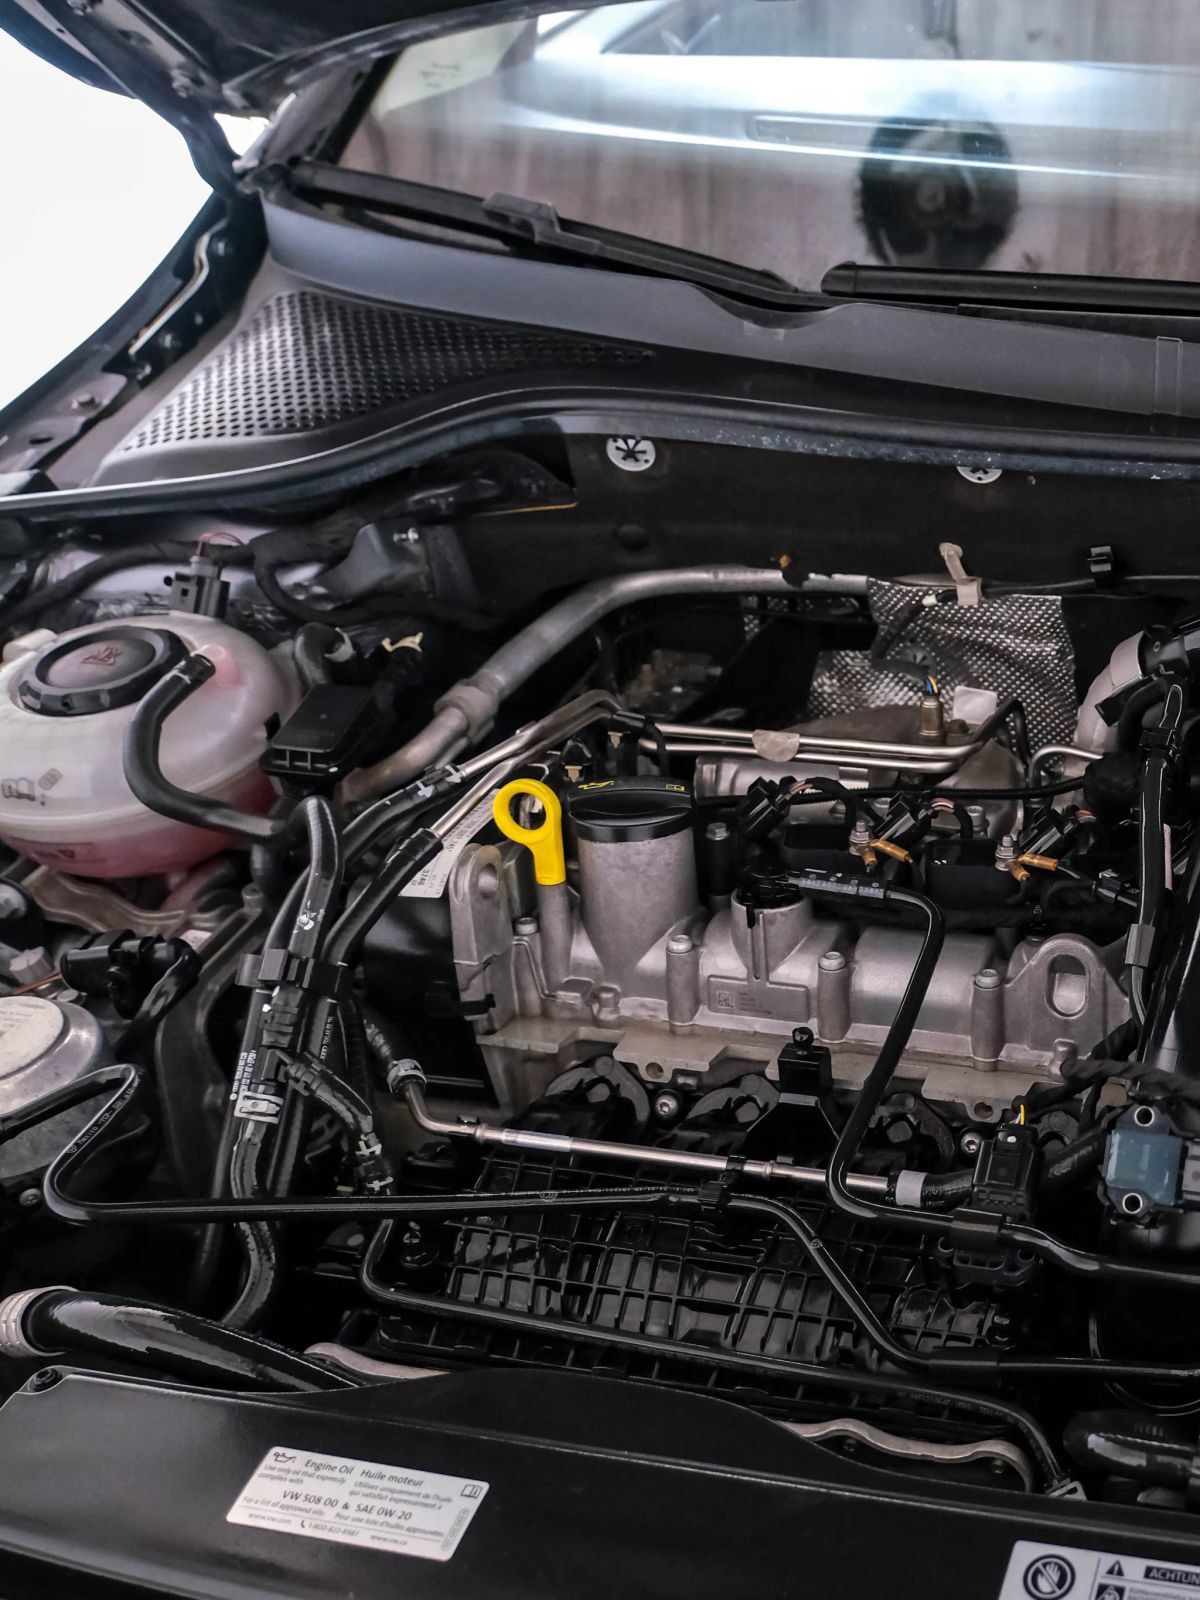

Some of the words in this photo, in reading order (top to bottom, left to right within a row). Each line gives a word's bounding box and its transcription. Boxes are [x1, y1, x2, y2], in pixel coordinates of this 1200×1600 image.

[305, 1460, 337, 1471] Engine
[339, 1465, 354, 1474] Oil
[361, 1469, 386, 1480] Huile
[387, 1474, 424, 1486] moteur
[283, 1490, 302, 1500] VW
[304, 1493, 322, 1505] 508
[323, 1497, 339, 1507] 00
[355, 1503, 376, 1514] SAE
[376, 1507, 413, 1520] 0W-20
